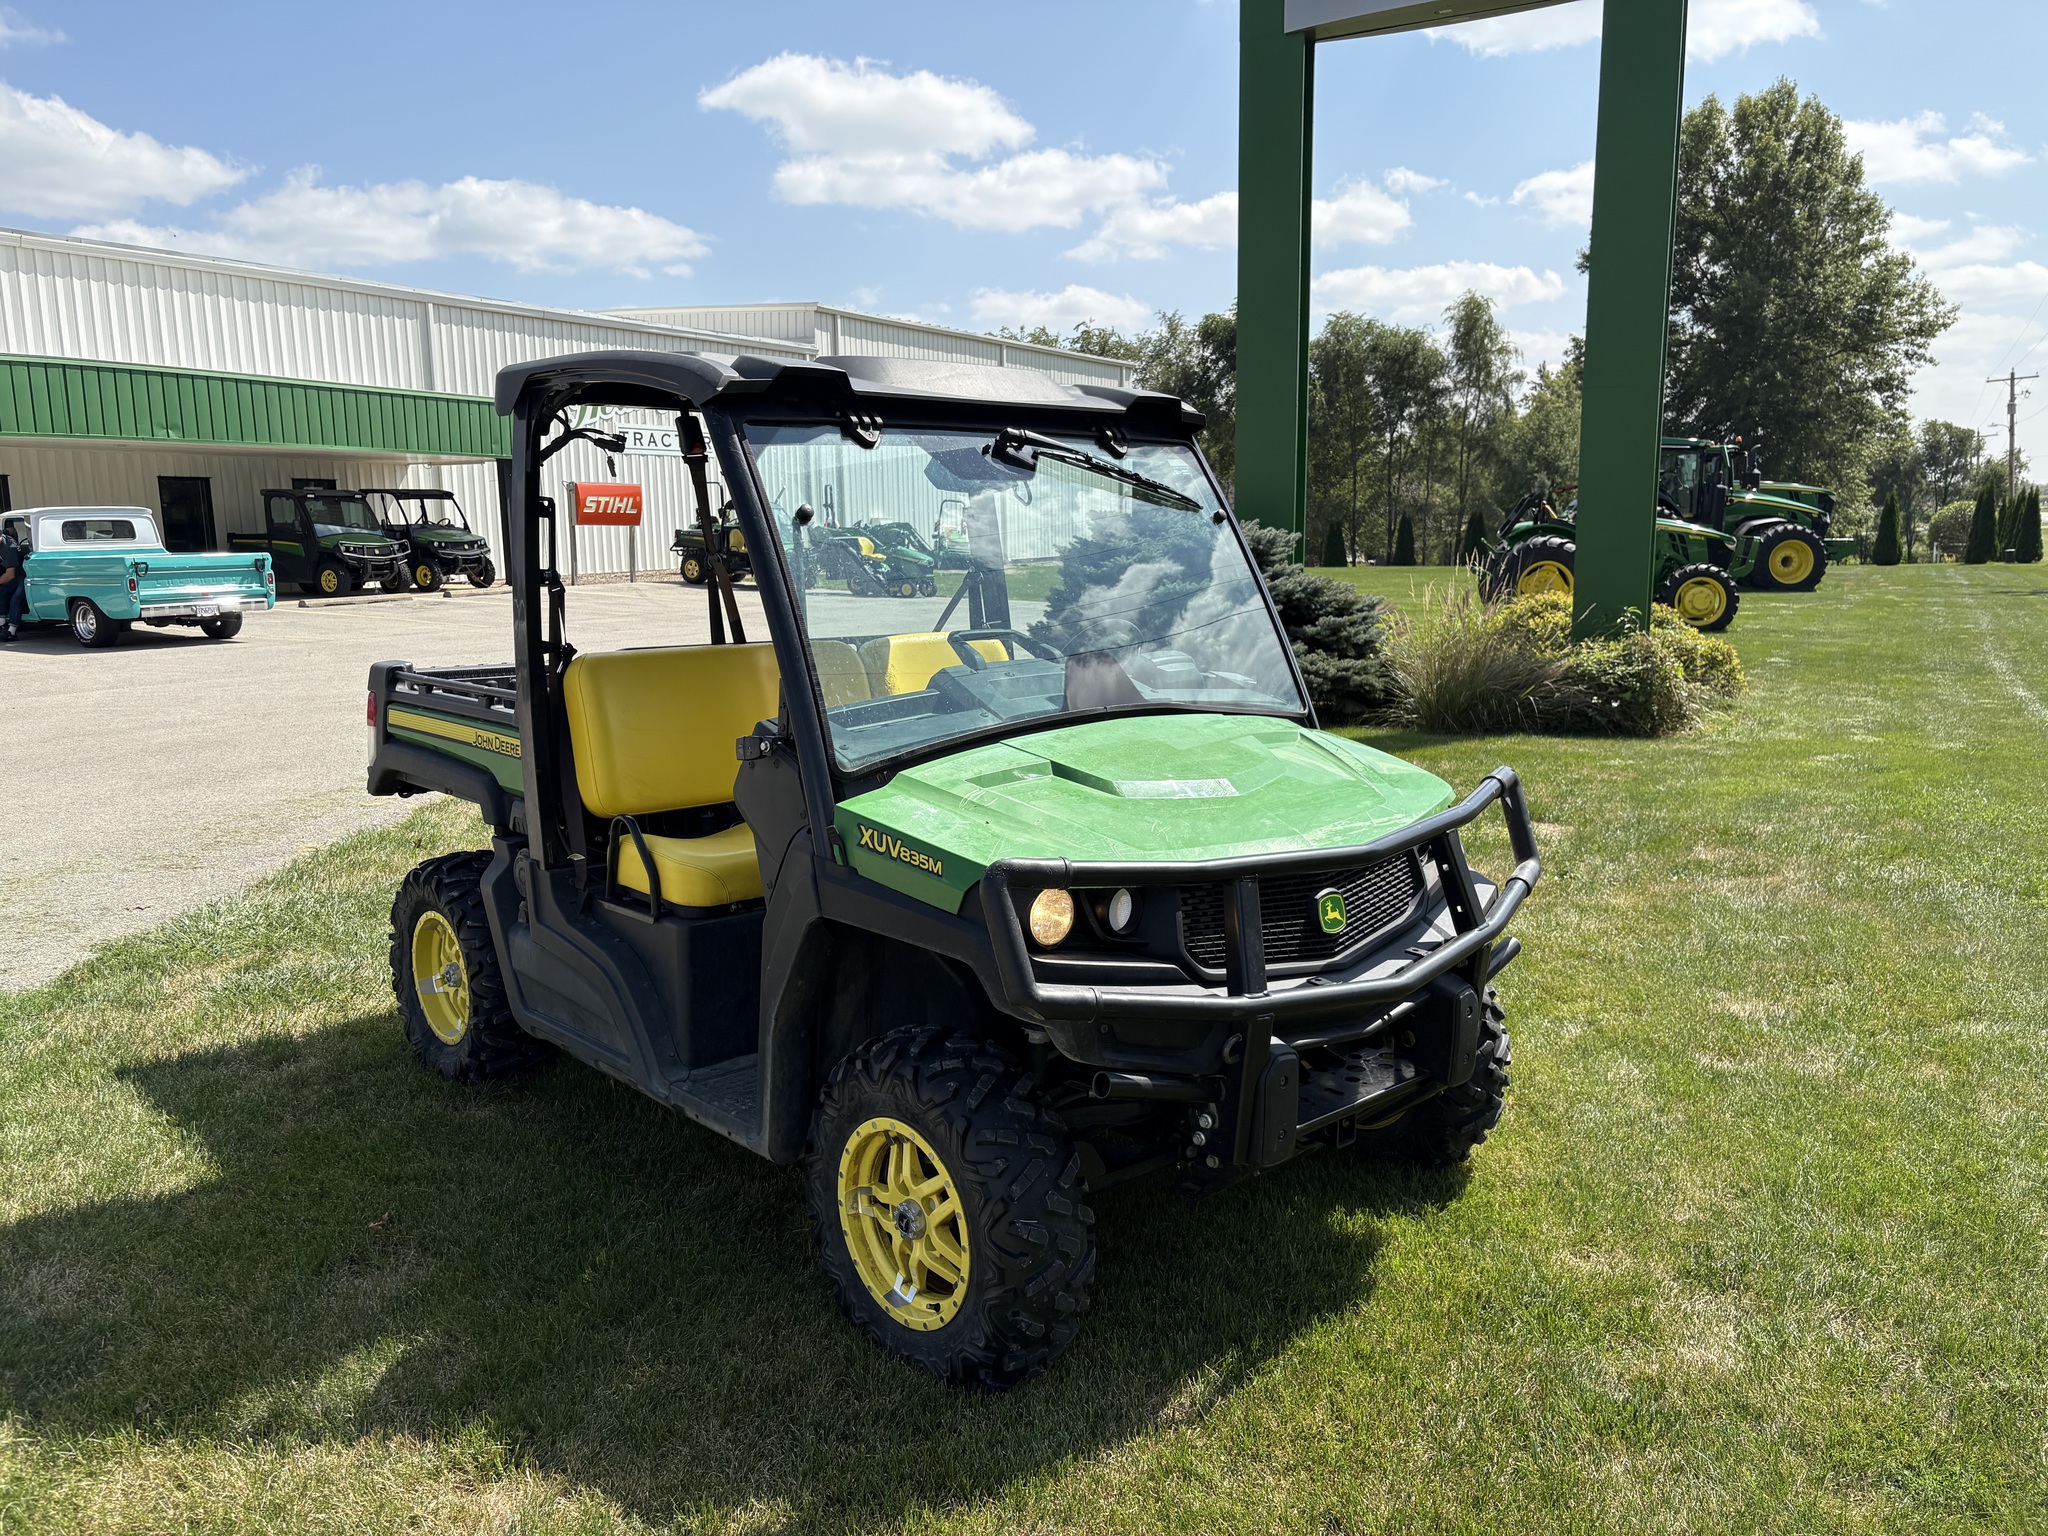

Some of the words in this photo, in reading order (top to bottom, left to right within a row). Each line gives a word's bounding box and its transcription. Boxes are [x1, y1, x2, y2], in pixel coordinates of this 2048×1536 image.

[618, 430, 712, 450] TRACR
[583, 495, 638, 514] STIHL
[472, 731, 495, 750] JOHN
[494, 736, 520, 755] DEERE
[859, 824, 942, 876] XUV835M
